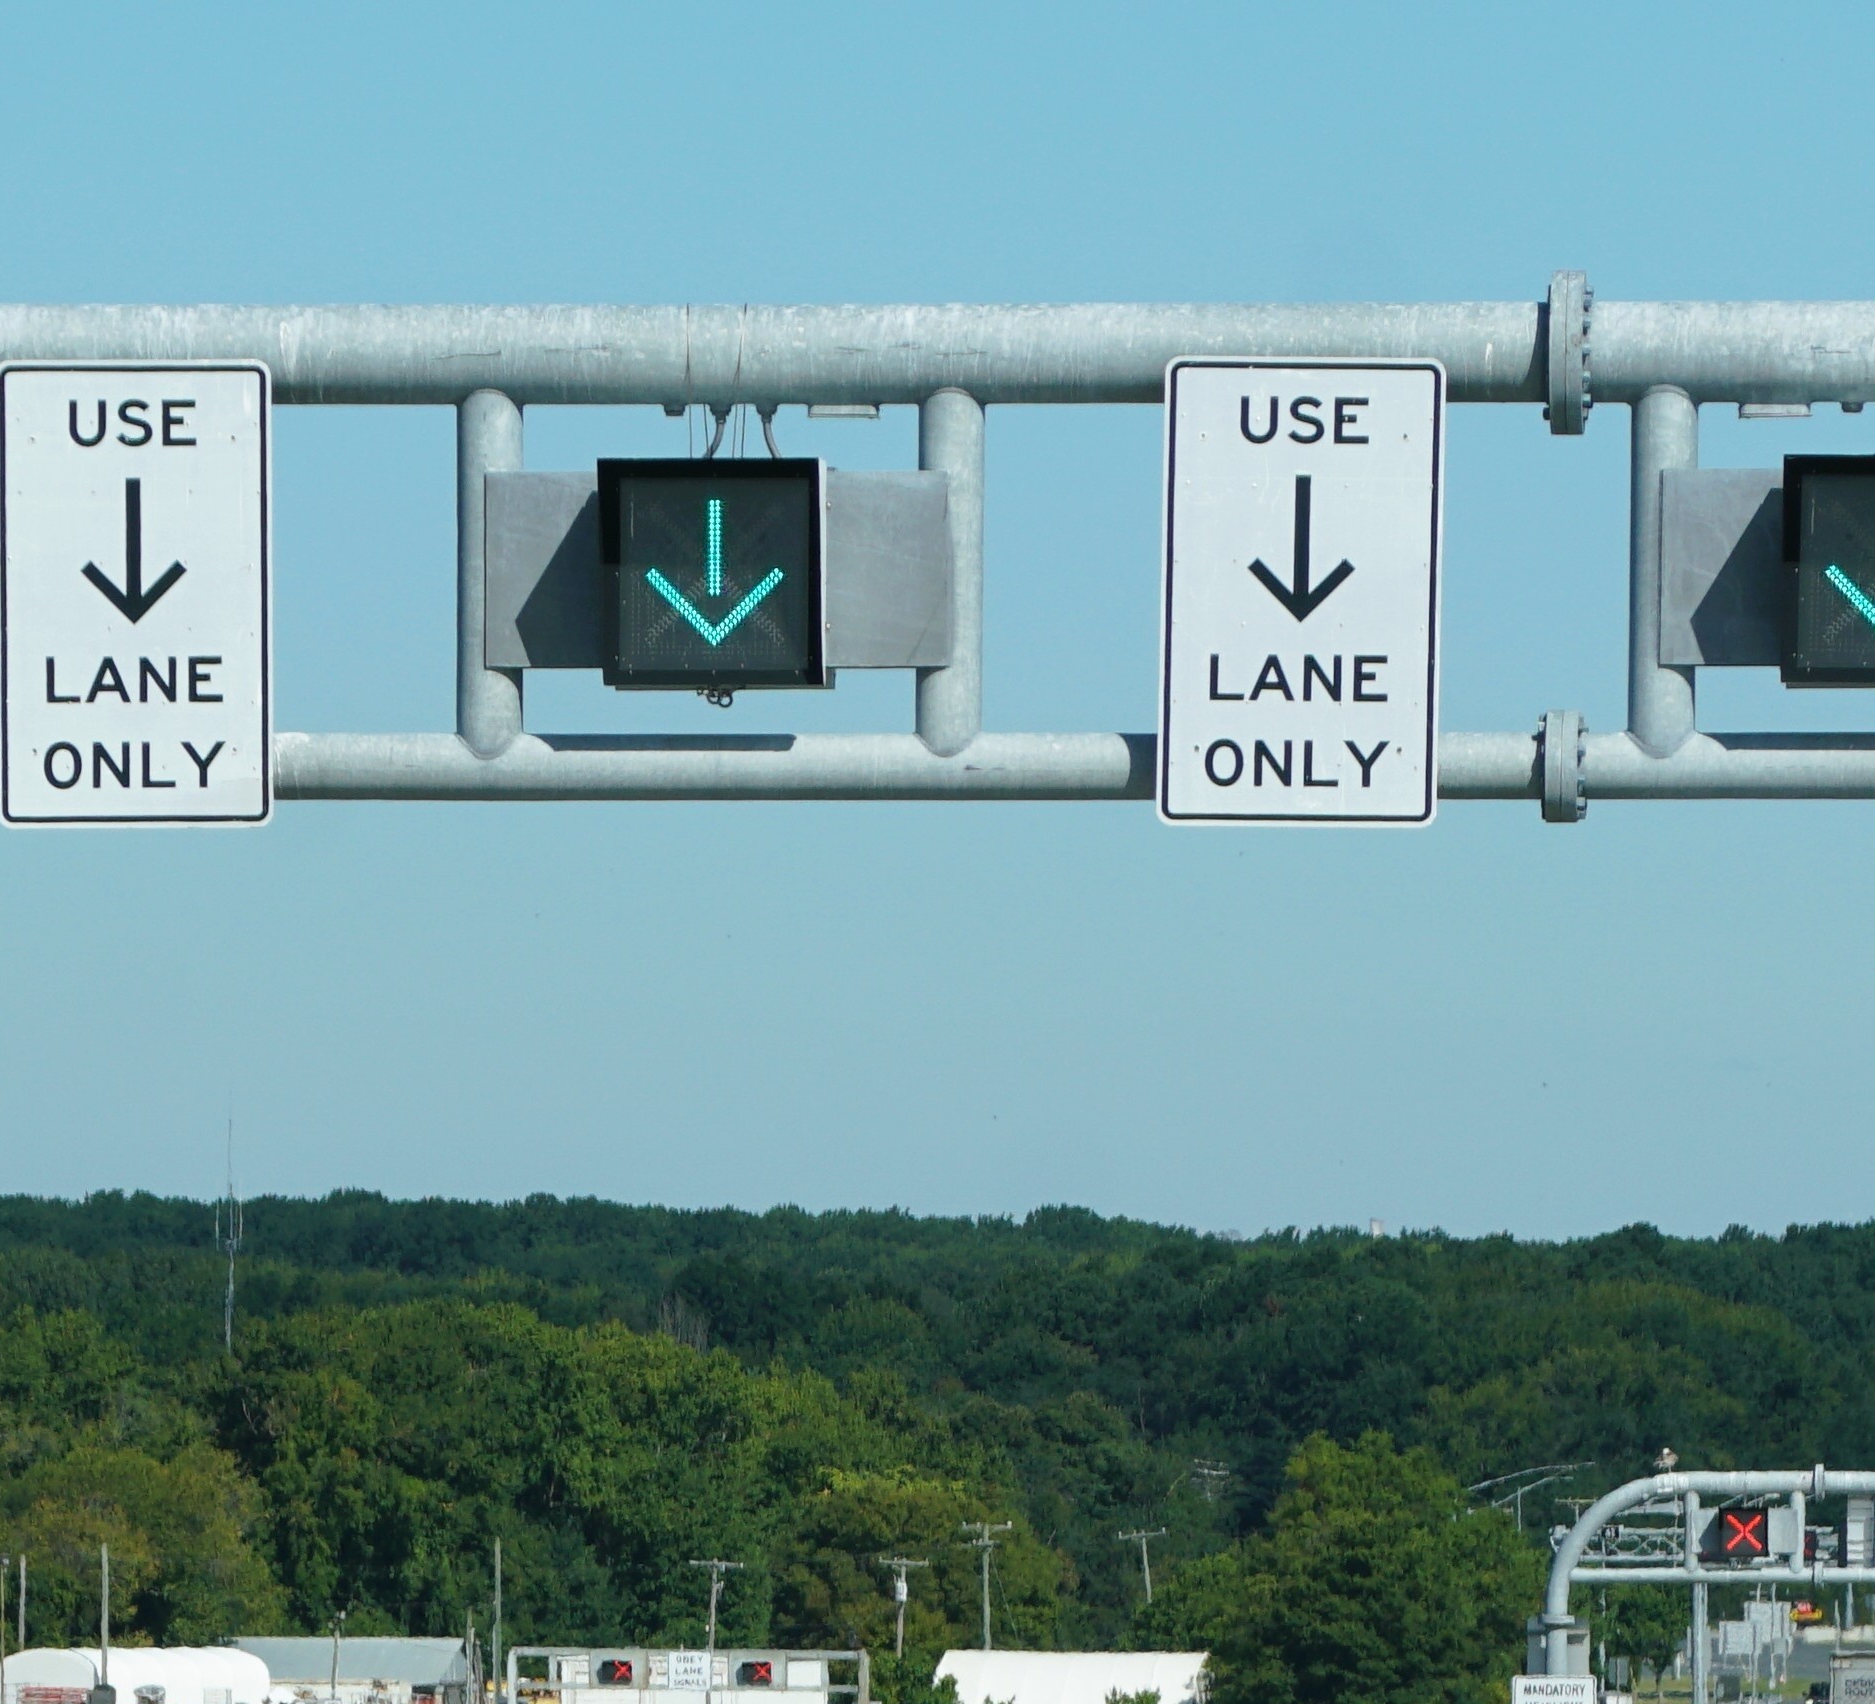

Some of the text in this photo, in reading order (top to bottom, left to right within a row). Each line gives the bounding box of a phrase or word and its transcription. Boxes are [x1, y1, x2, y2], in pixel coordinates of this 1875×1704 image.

[68, 398, 197, 447] USE
[1240, 395, 1370, 445] USE
[45, 655, 223, 704] LANE
[1209, 653, 1389, 702] LANE
[43, 740, 225, 790] ONLY
[1204, 738, 1391, 788] ONLY
[1523, 1683, 1586, 1697] MANDATORY
